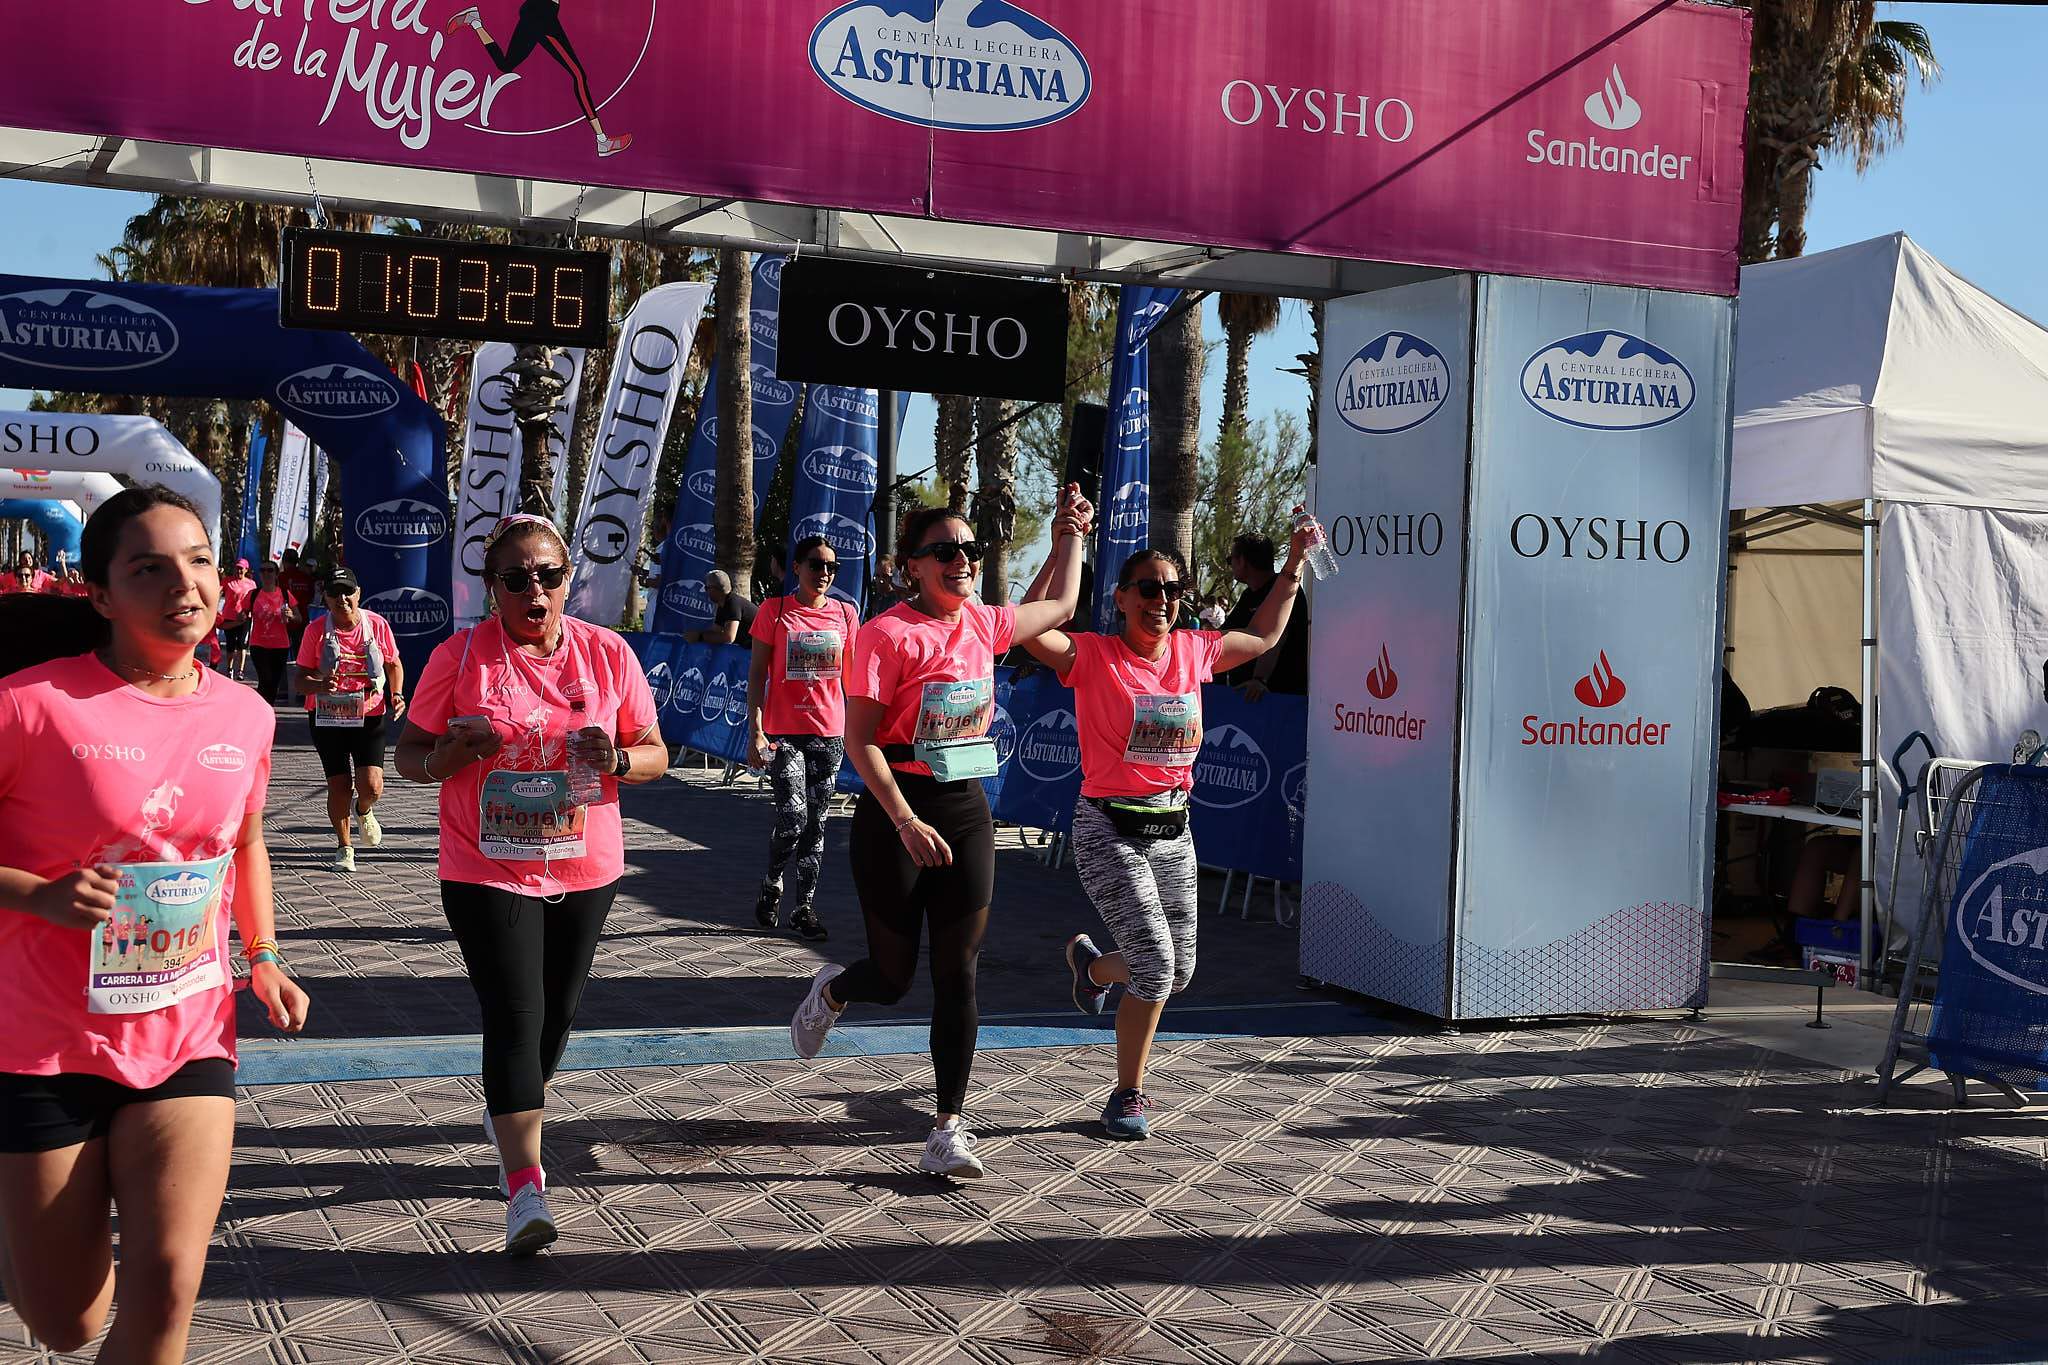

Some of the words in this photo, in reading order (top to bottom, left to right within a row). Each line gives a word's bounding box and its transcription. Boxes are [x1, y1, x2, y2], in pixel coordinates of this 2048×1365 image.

[233, 19, 282, 71] de
[293, 22, 328, 78] la
[877, 27, 965, 49] CENTRAL
[974, 39, 1062, 61] LECHERA
[831, 25, 1070, 103] ASTURIANA
[318, 27, 522, 150] Mujer
[1221, 80, 1414, 143] OYSHO
[1526, 129, 1691, 181] Santander
[18, 308, 80, 322] CENTRAL
[86, 312, 157, 328] LECHERA
[828, 302, 1028, 360] OYSHO
[1358, 366, 1396, 381] CENTRAL
[1397, 361, 1438, 377] LECHERA
[1532, 362, 1682, 409] ASTURIANA
[1560, 361, 1616, 376] CENTRAL
[1620, 366, 1677, 380] LECHERA
[287, 385, 392, 405] ASTURIANA
[1342, 374, 1441, 412] ASTURIANA
[0, 422, 100, 457] SHO
[581, 324, 680, 566] OYSHO
[145, 462, 193, 474] OYSHO
[361, 517, 443, 536] ASTURIANA
[1331, 512, 1444, 557] OYSHO
[1510, 513, 1691, 564] OYSHO
[664, 589, 714, 614] ASTURIAN
[945, 715, 971, 729] 016
[1333, 702, 1426, 741] Santander
[1521, 715, 1671, 746] Santander
[73, 743, 146, 762] OYSHO
[514, 810, 555, 827] 016
[151, 885, 208, 898] ASTURIANA
[150, 924, 200, 953] 016
[101, 974, 143, 986] CARRERA
[146, 974, 158, 984] DE
[160, 972, 169, 982] LA
[109, 991, 160, 1005] OYSHO
